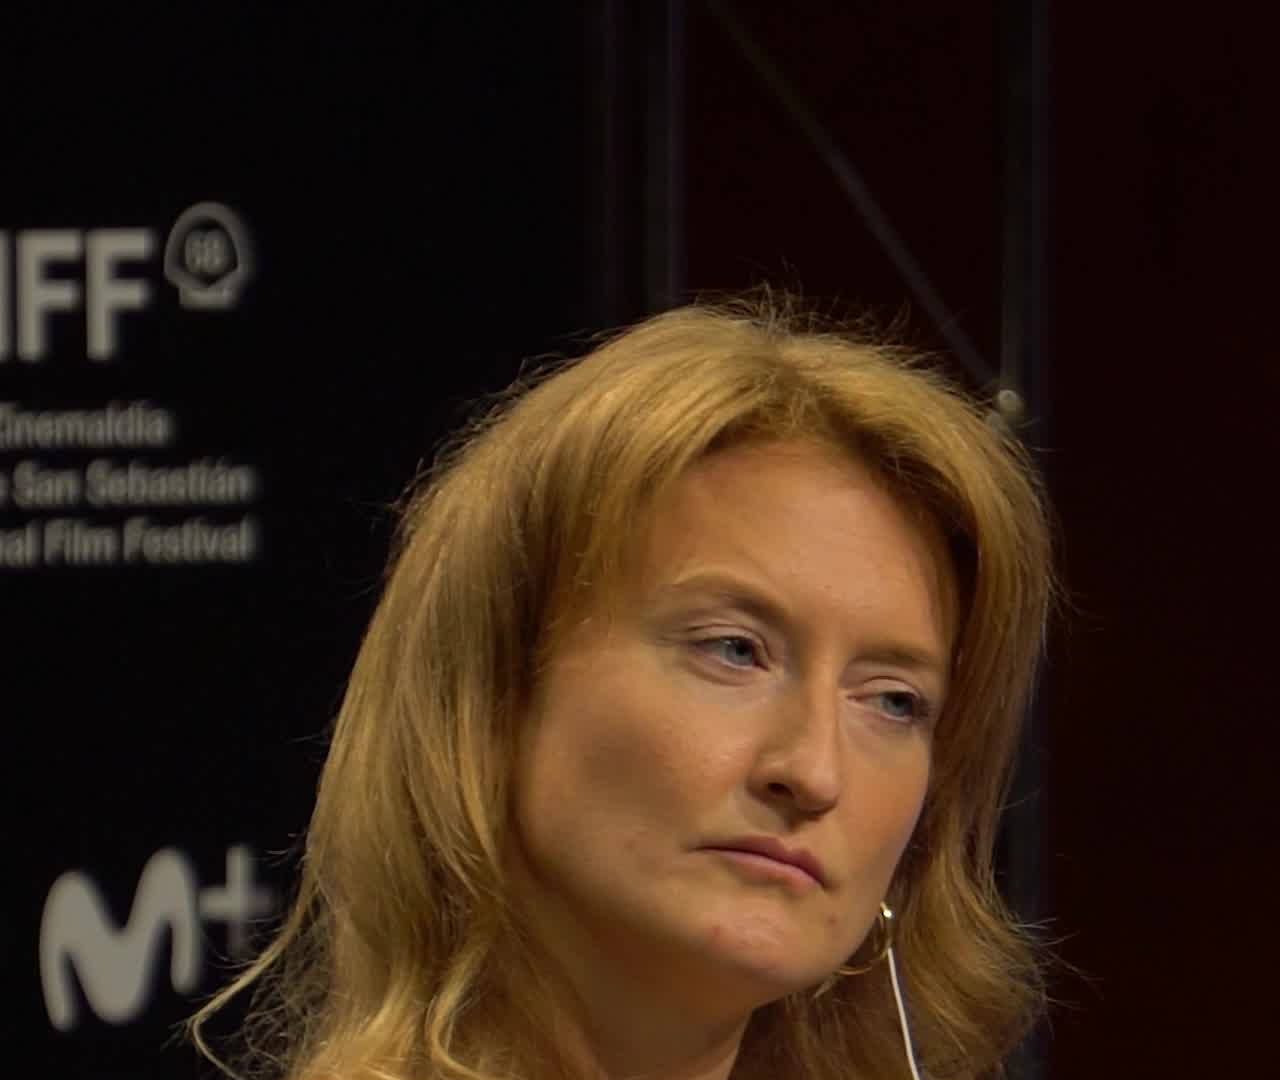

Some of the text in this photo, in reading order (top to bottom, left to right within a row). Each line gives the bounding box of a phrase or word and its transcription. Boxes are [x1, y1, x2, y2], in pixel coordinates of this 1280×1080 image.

[13, 460, 80, 507] San
[85, 457, 258, 507] Sebastián
[43, 518, 118, 566] Film
[123, 513, 259, 566] Festival
